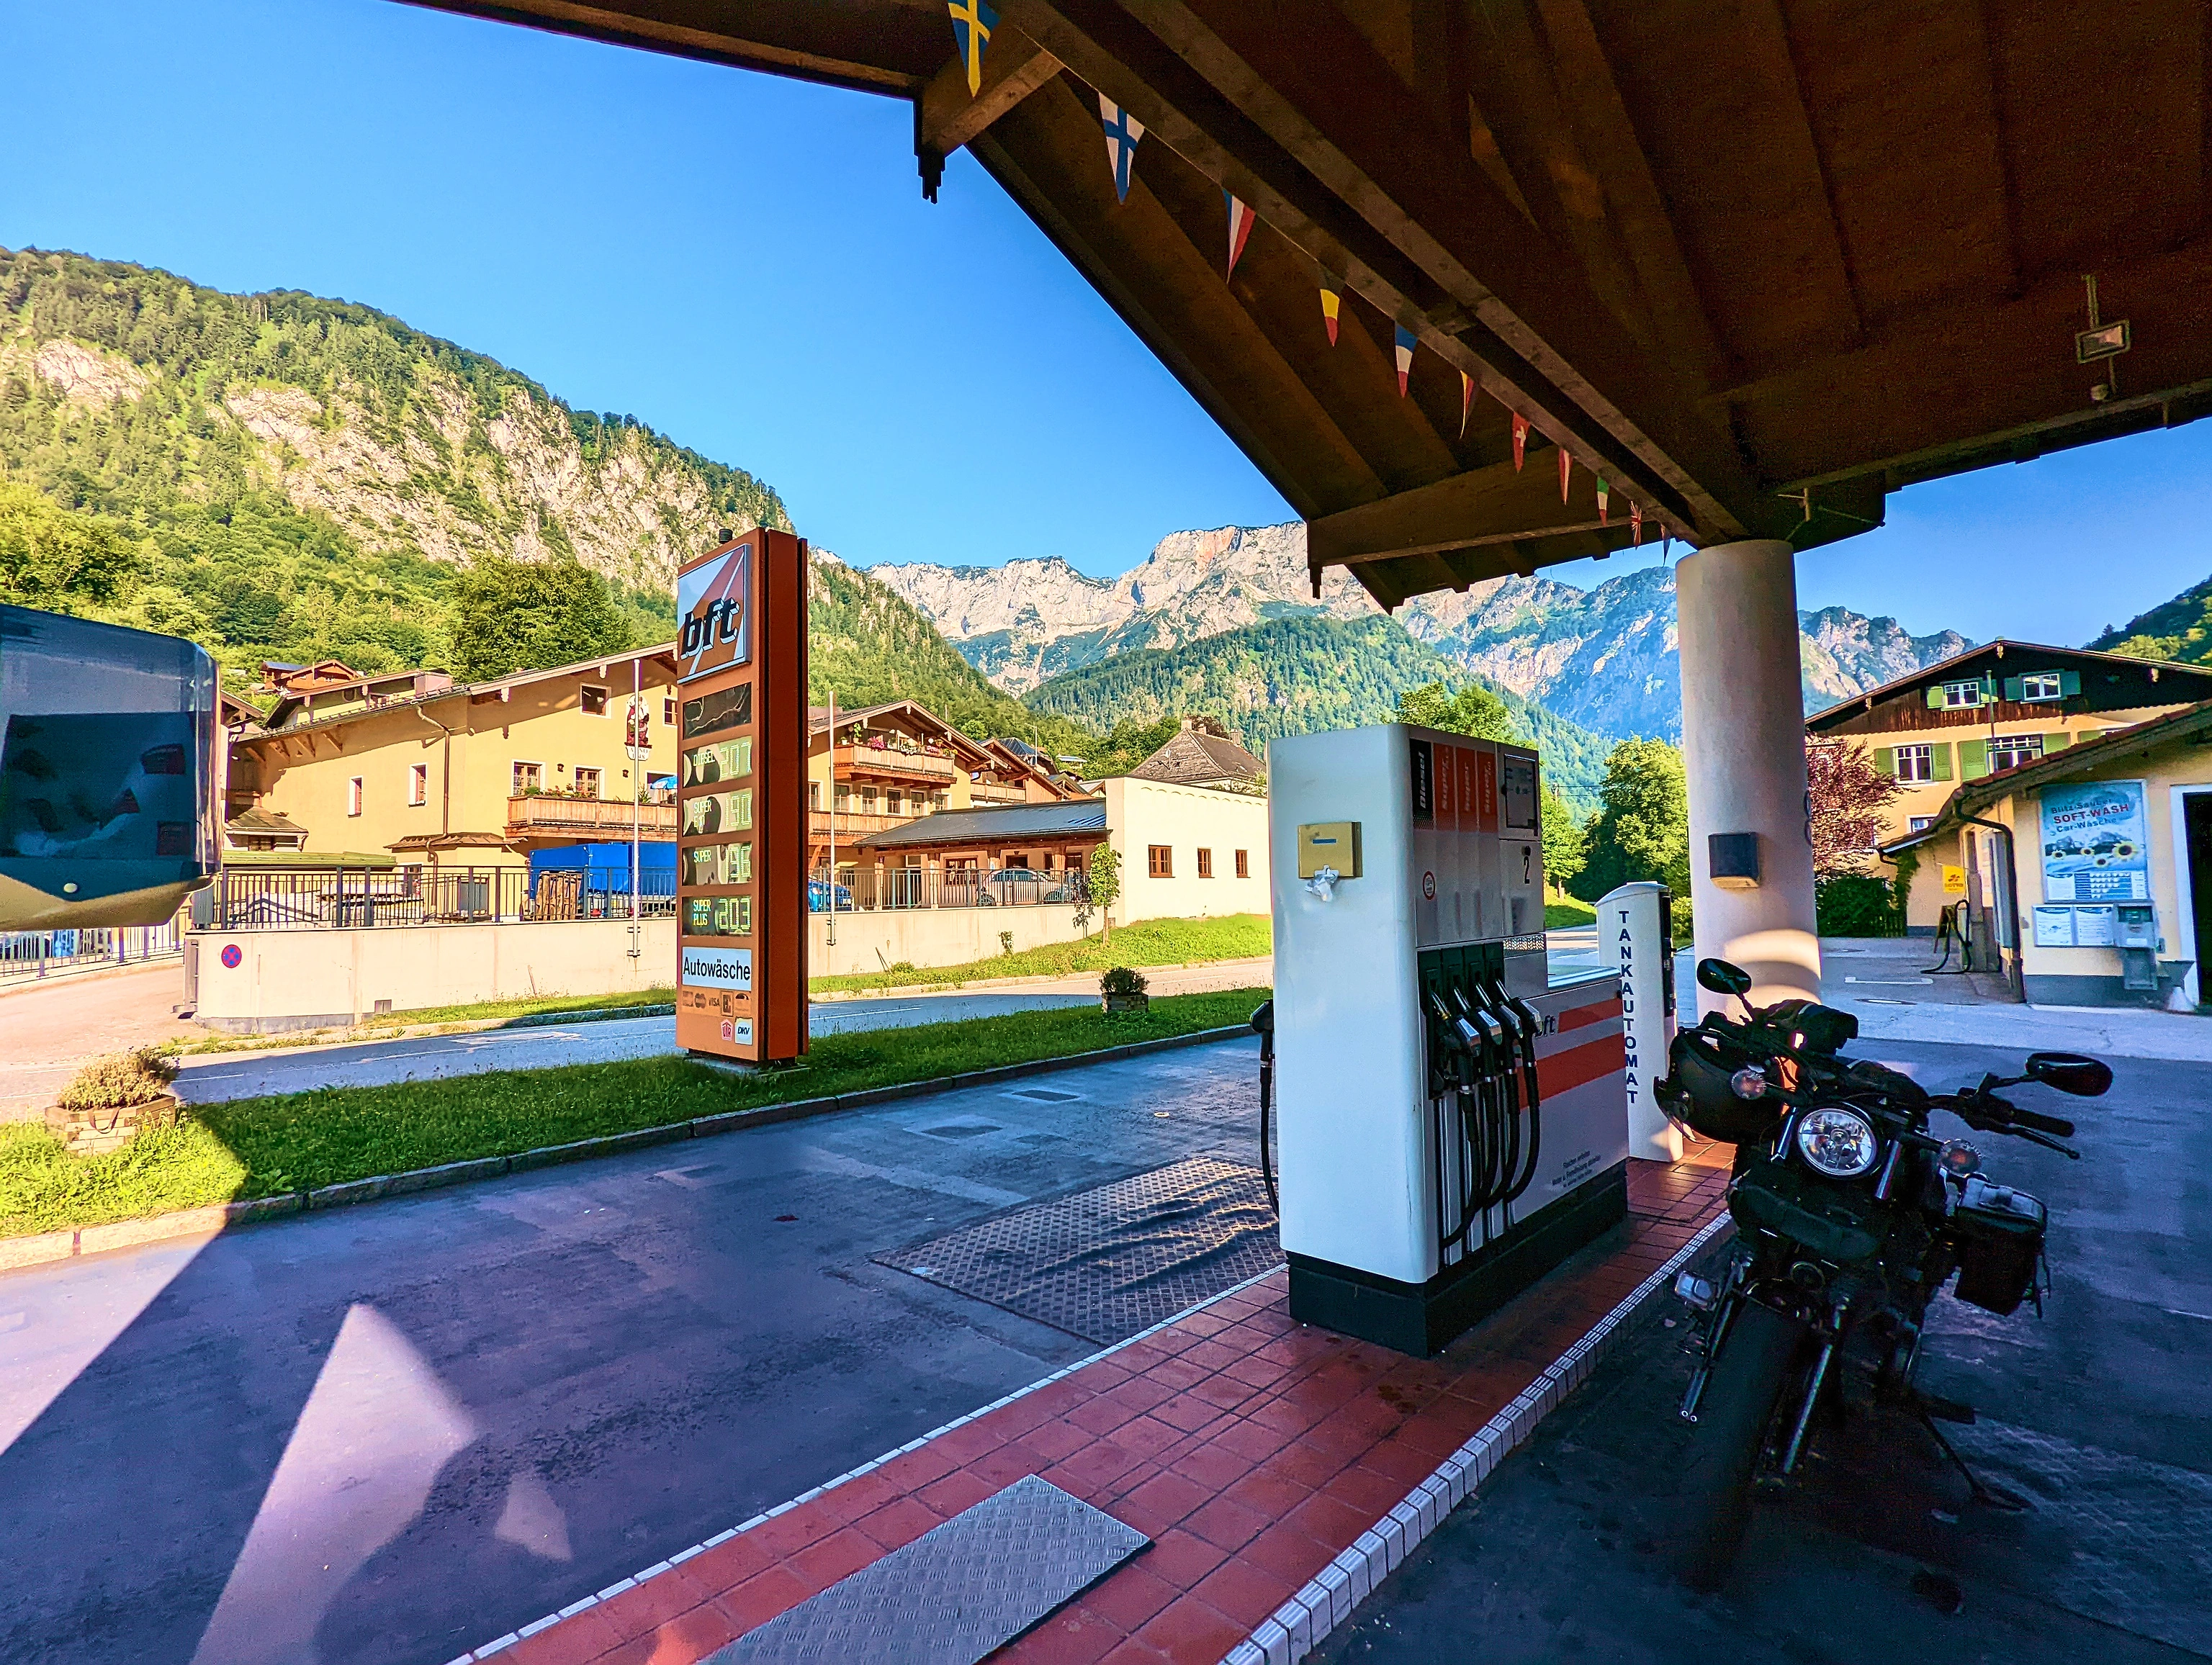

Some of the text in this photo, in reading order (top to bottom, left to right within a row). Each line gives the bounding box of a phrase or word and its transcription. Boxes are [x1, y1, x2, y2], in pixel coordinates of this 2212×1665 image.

[680, 597, 740, 660] bft
[693, 741, 752, 778] DIESEL 207
[693, 793, 752, 827] SUPER 190
[2053, 803, 2129, 824] SOFT-WASH
[693, 845, 751, 878] SUPER 196
[1523, 856, 1530, 884] 2
[693, 898, 751, 930] SUPER 203
[693, 913, 708, 926] PLUS
[683, 956, 750, 980] Autowäsche
[1619, 911, 1638, 1104] TANKAUTOMAT
[737, 1026, 750, 1035] DKV
